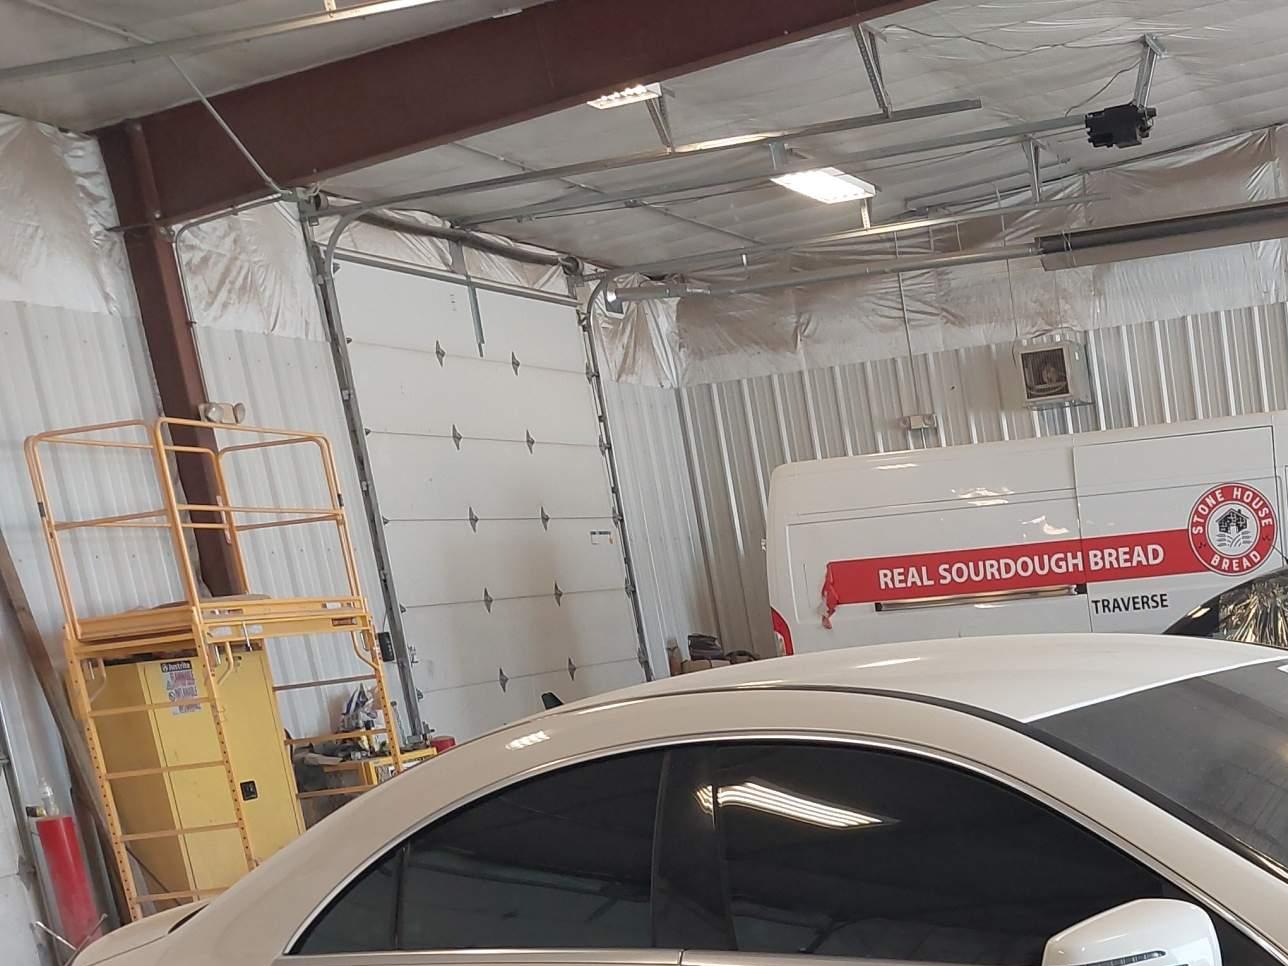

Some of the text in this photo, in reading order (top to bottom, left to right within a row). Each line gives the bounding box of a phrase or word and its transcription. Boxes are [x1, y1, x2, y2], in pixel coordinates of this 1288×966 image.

[1192, 487, 1273, 534] STONE HOUSE
[878, 544, 1165, 590] REAL SOURDOUGH BREAD
[1210, 550, 1261, 571] BREAD
[1091, 593, 1169, 615] TRAVERSE
